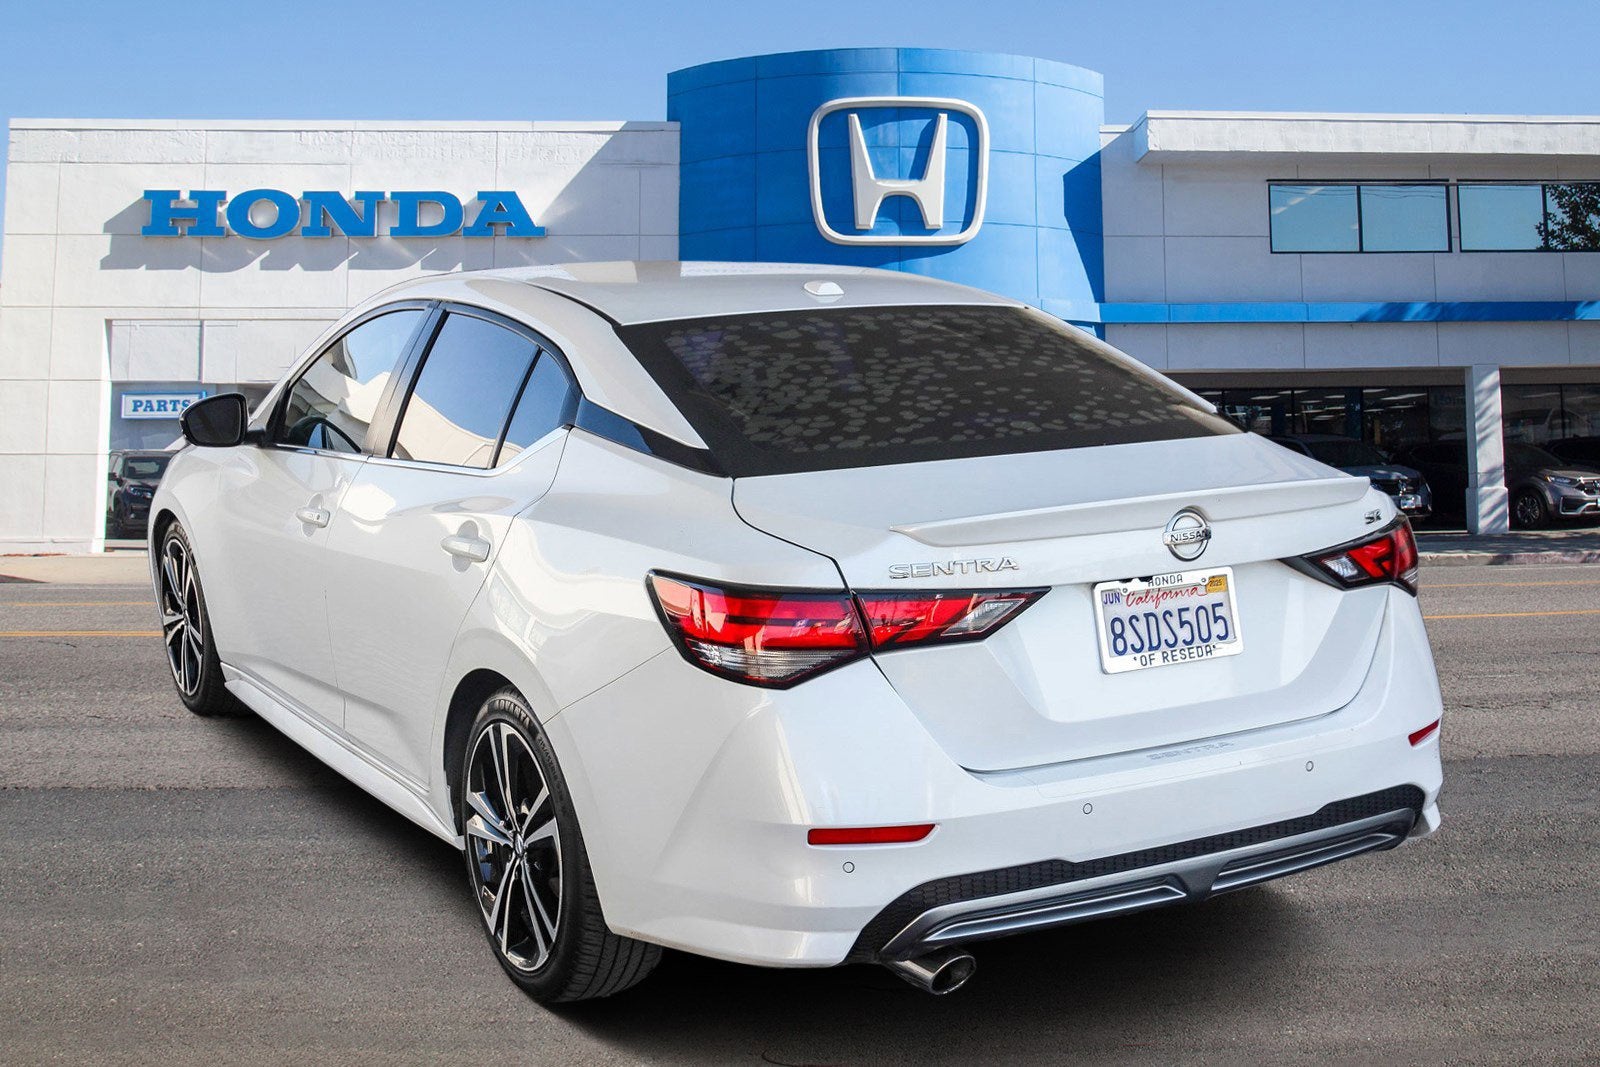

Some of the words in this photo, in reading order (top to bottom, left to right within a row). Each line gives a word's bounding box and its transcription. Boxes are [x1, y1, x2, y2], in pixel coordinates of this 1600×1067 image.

[141, 188, 548, 240] HONDA
[1170, 529, 1206, 542] NISSAN
[889, 557, 1019, 579] SENTRA
[1147, 573, 1184, 588] HONDA
[1103, 592, 1121, 605] JUN
[1126, 586, 1208, 609] California
[1110, 603, 1229, 656] 8SDS505
[1140, 654, 1156, 666] OF
[1162, 644, 1214, 663] RESEDA
